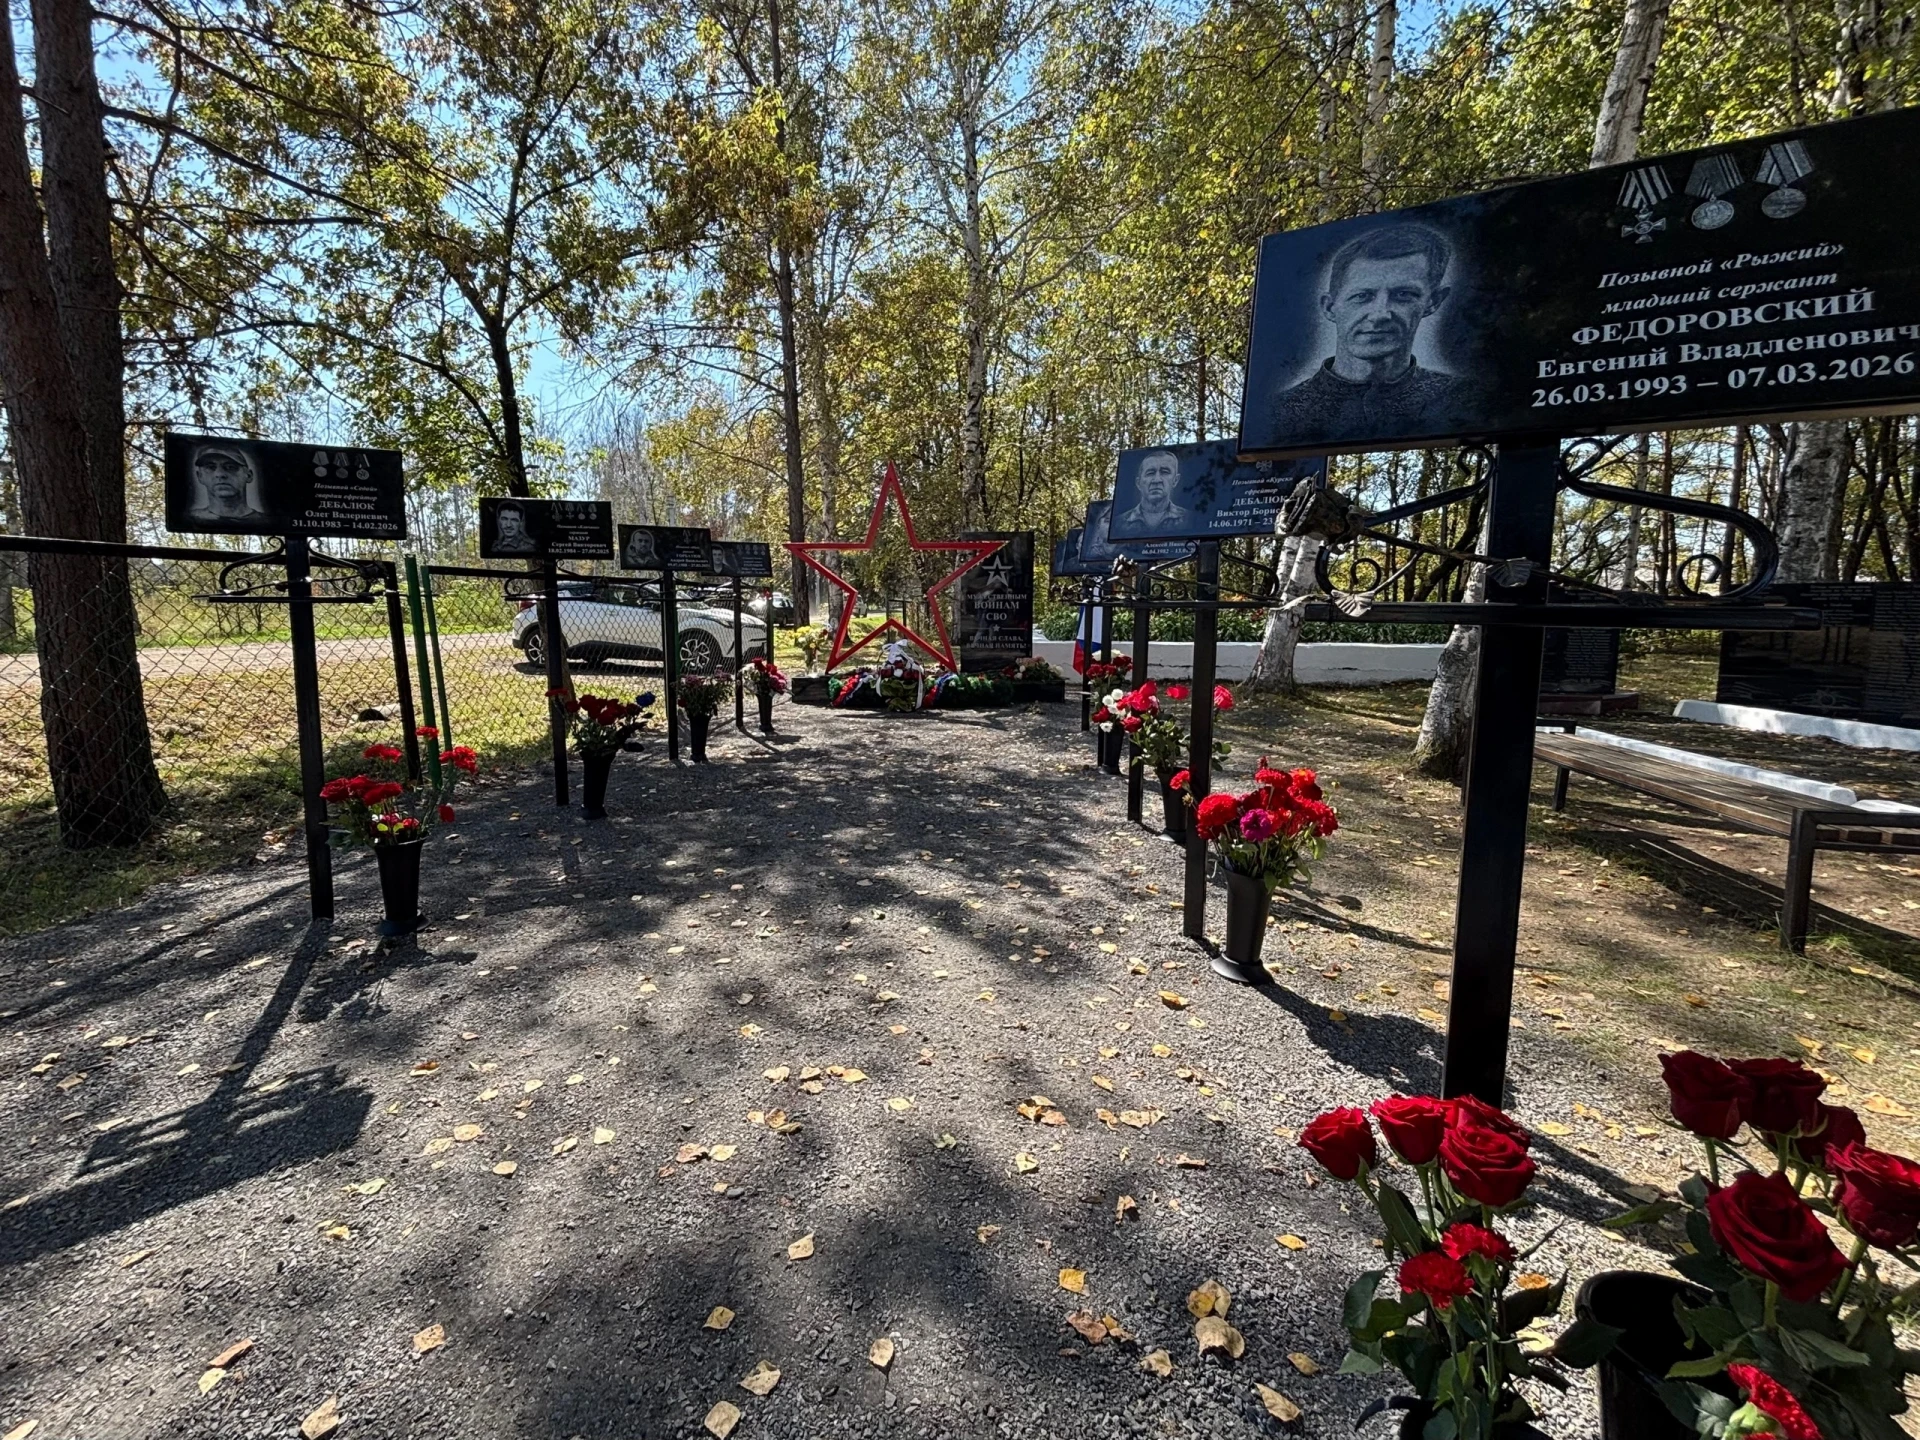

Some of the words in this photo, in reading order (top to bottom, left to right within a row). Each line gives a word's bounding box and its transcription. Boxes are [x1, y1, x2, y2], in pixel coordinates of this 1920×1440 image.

[1597, 258, 1713, 289] Позывной
[1720, 242, 1845, 270] «Рыжий»
[1600, 286, 1711, 314] младший
[1717, 273, 1838, 299] сержант
[1571, 287, 1876, 345] ФЕДОРОВСКИЙ
[1536, 347, 1668, 378] Евгений
[1678, 324, 1920, 363] Владленович
[1531, 374, 1687, 407] 26.03.1993
[1727, 352, 1915, 389] 07.03.2026
[343, 494, 378, 502] ефрейтор
[1232, 495, 1288, 507] ДЕБАЛЮК
[318, 501, 375, 510] ДЕБАЛЮК
[304, 510, 330, 518] Олег
[332, 511, 388, 521] Валериевич
[1217, 509, 1250, 517] Виктор
[1252, 507, 1281, 516] Борис
[292, 520, 341, 528] 31.10.1983
[352, 522, 398, 530] 14.02.2026
[1208, 518, 1252, 528] 14.06.1971
[975, 601, 1020, 609] ВОИНАМ
[986, 612, 1007, 621] СВО
